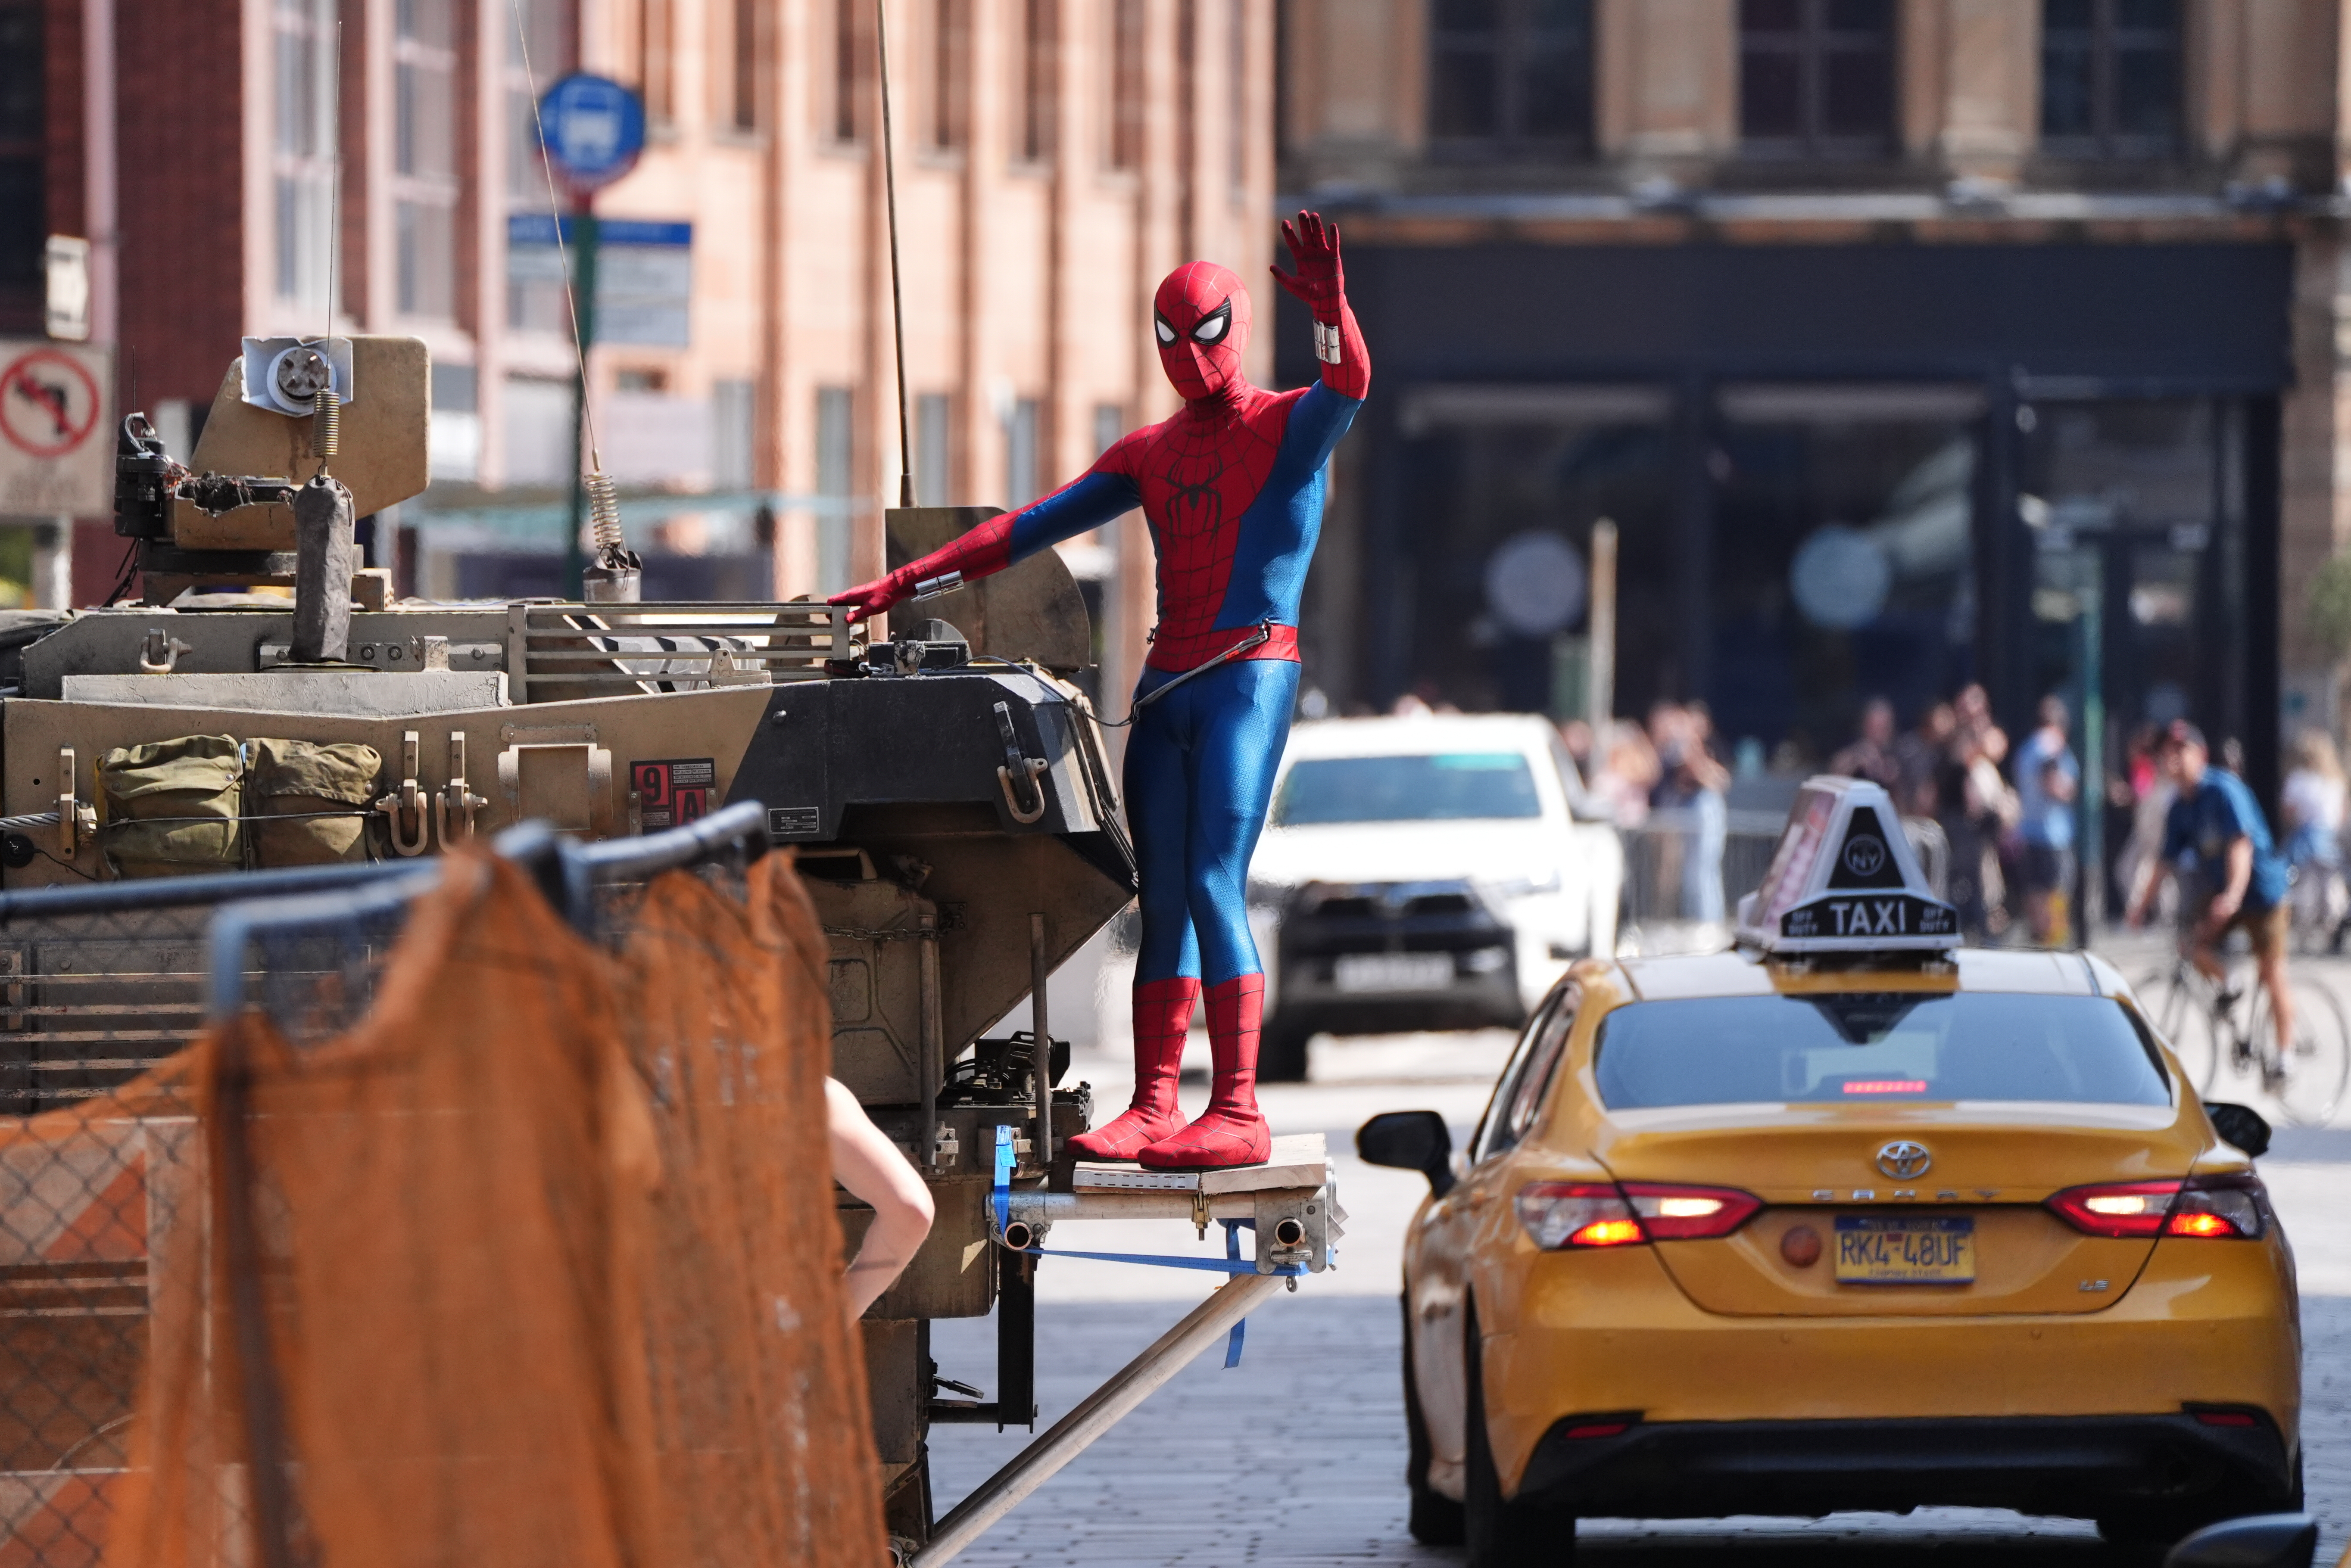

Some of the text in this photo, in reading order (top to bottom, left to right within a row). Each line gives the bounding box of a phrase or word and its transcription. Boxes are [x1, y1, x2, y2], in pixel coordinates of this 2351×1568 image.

[643, 767, 661, 803] 9
[682, 792, 699, 826] A
[1829, 901, 1906, 935] TAXI
[2079, 1279, 2110, 1291] LE
